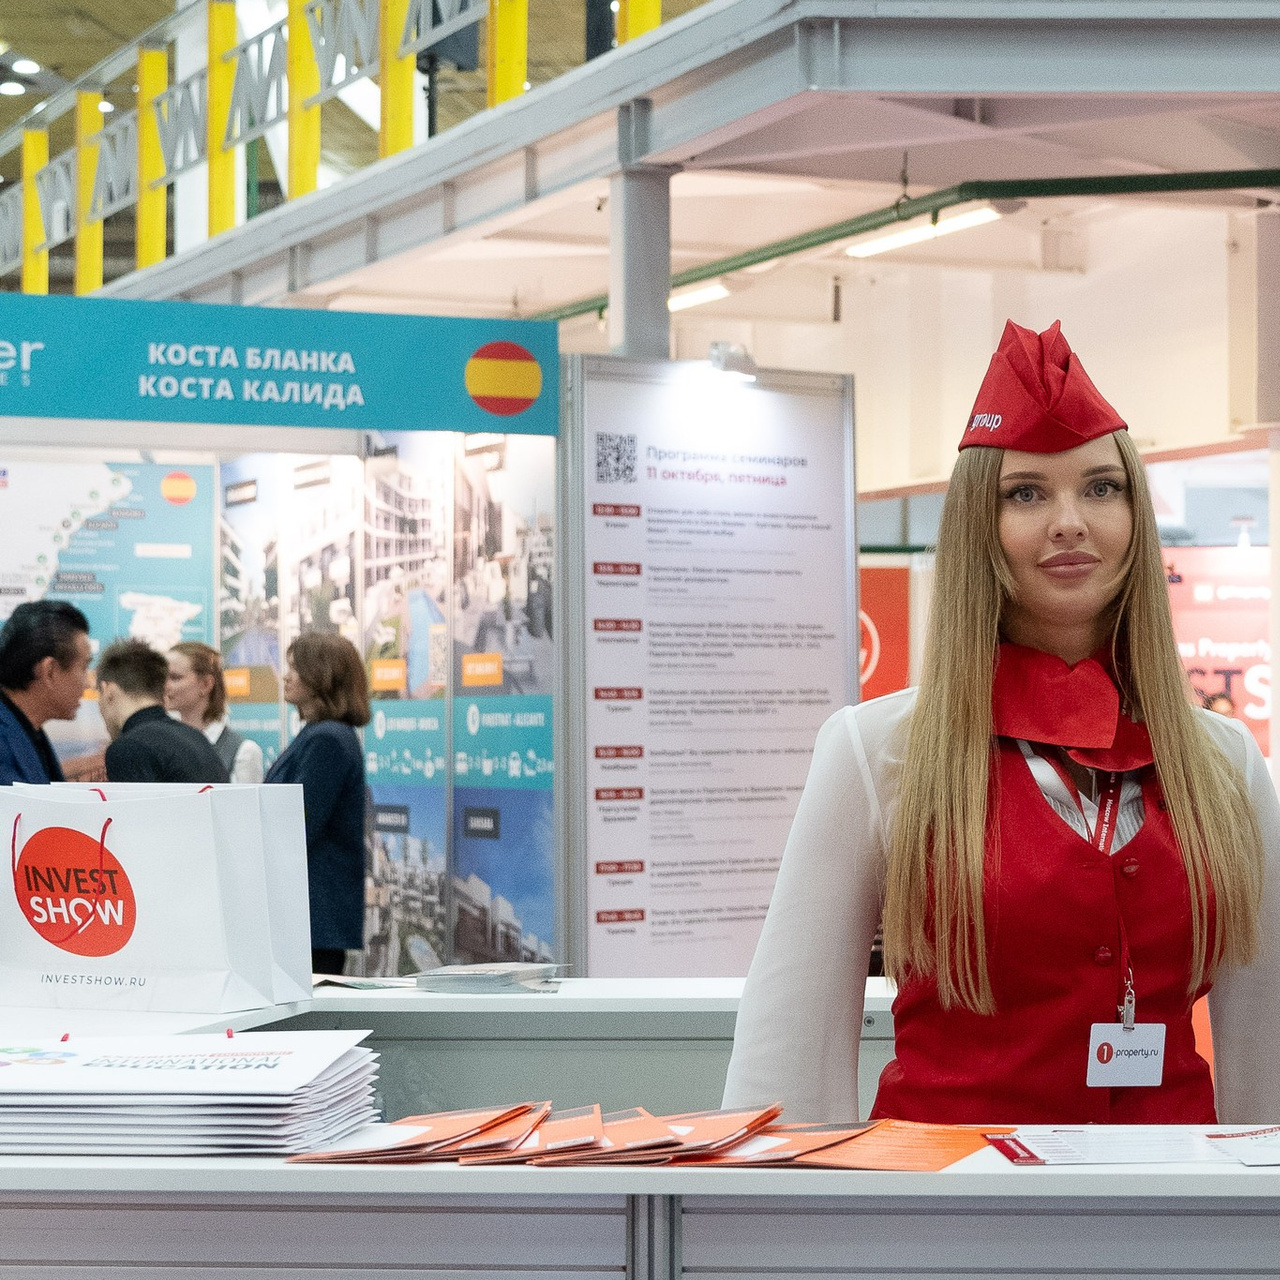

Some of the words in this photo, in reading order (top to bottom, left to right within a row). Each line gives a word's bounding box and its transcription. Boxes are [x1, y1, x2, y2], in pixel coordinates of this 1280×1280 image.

[148, 342, 239, 369] КОСТА
[245, 347, 356, 374] БЛАНКА
[138, 375, 234, 401] КОСТА
[243, 382, 365, 410] КАЛИДА
[729, 473, 787, 487] пятница
[24, 865, 118, 896] INVEST
[41, 974, 147, 988] INVESTSHOW.RU
